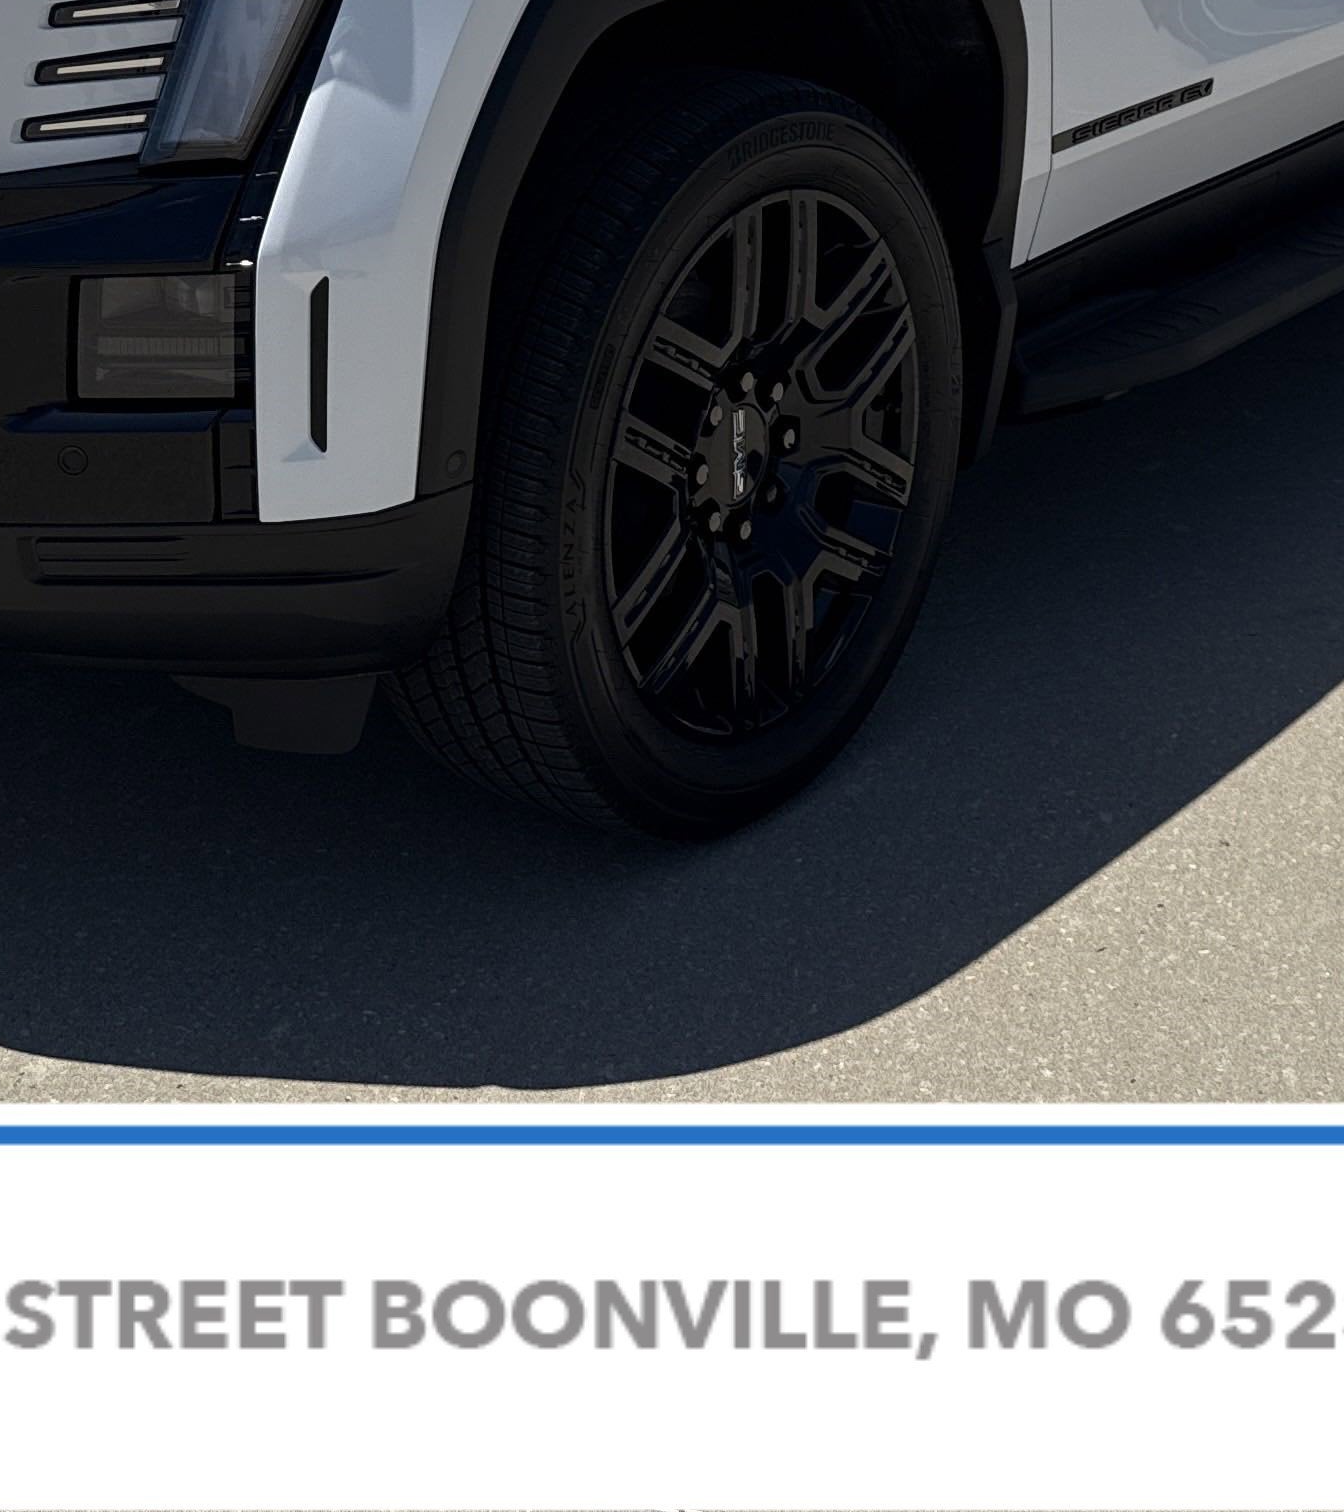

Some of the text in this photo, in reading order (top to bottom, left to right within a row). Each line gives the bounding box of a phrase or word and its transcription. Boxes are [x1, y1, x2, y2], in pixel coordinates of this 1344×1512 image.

[727, 120, 834, 171] BRIDGESTONE
[1071, 96, 1174, 144] SIERRA
[731, 408, 746, 500] GMC
